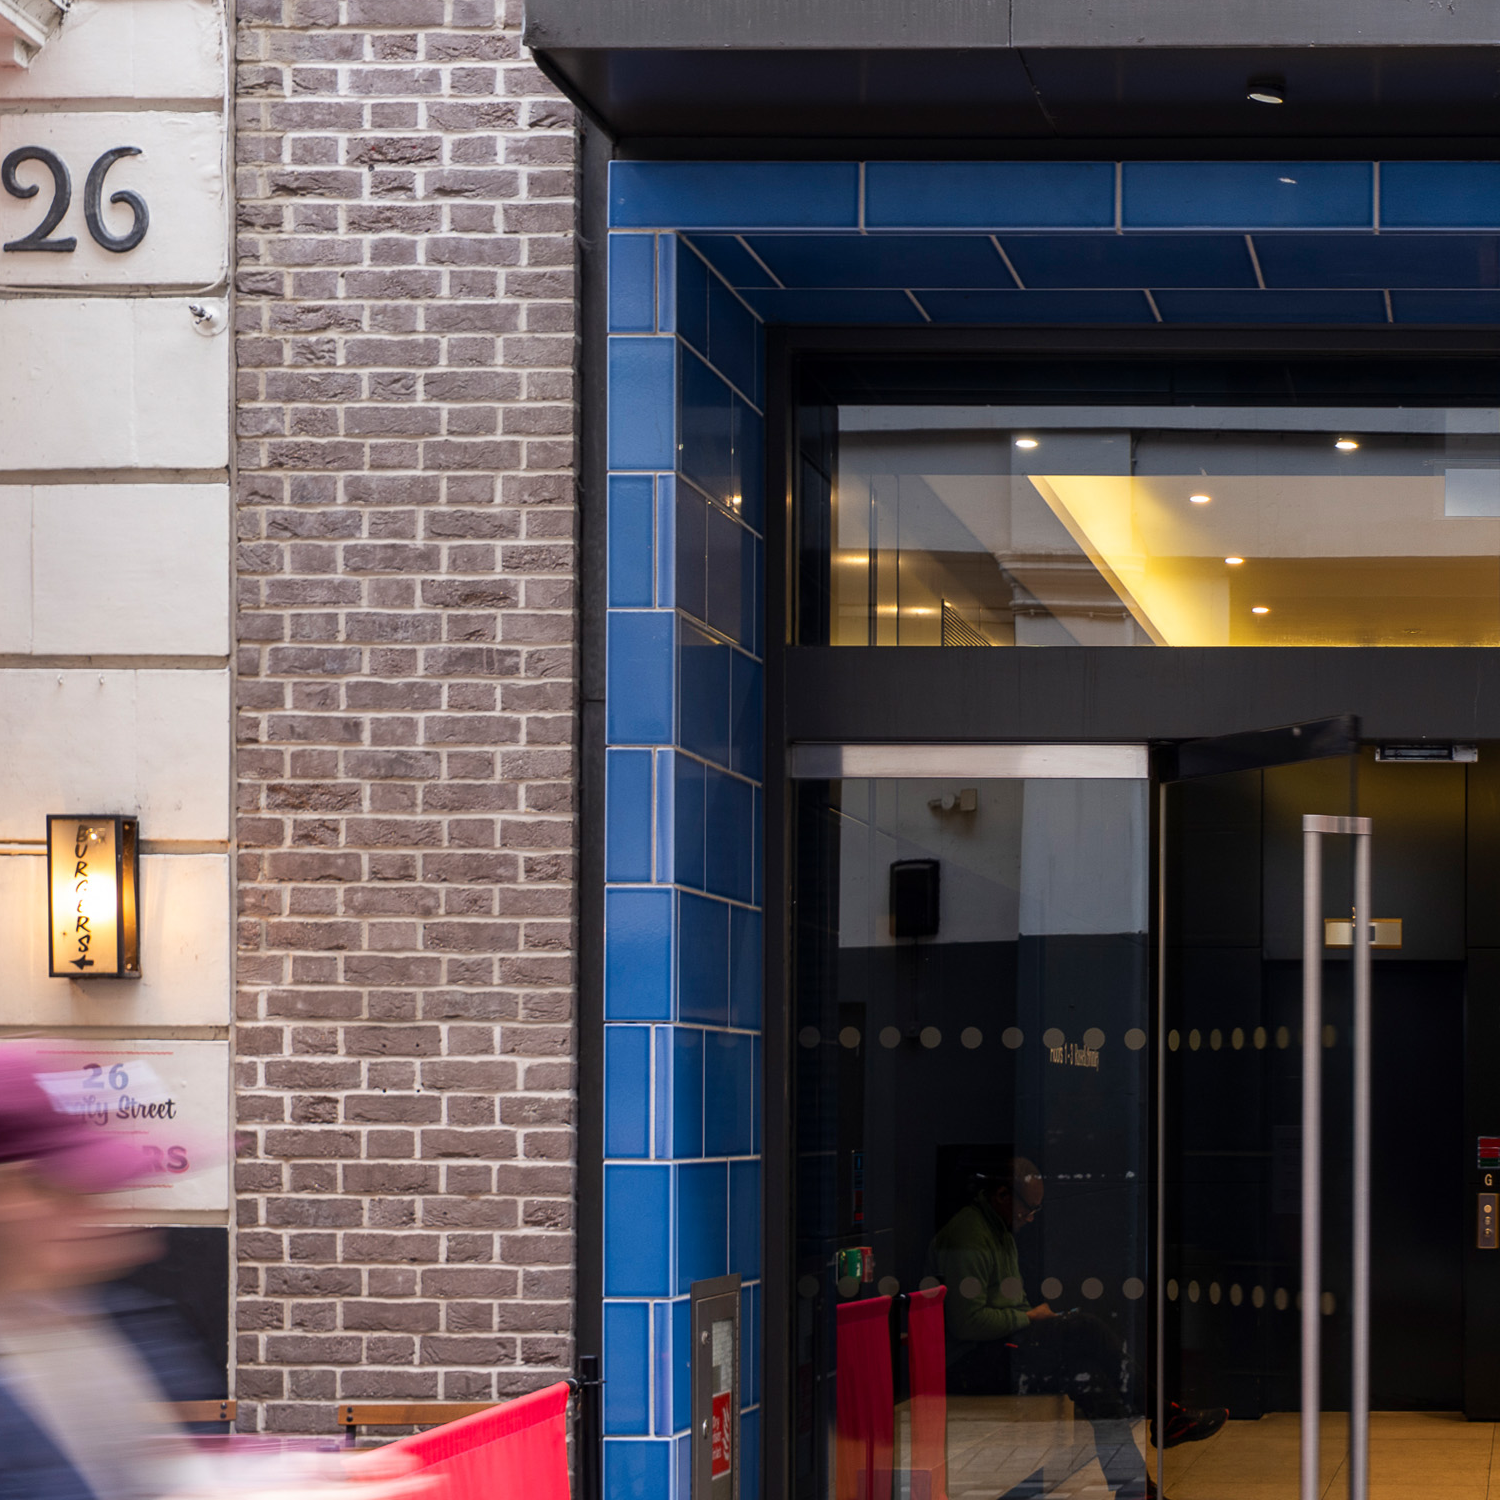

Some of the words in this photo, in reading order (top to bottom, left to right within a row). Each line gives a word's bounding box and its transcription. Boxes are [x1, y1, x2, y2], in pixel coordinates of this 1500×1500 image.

[0, 144, 151, 254] 26
[82, 1063, 129, 1090] 26
[116, 1094, 177, 1119] Street
[1484, 1173, 1493, 1186] G
